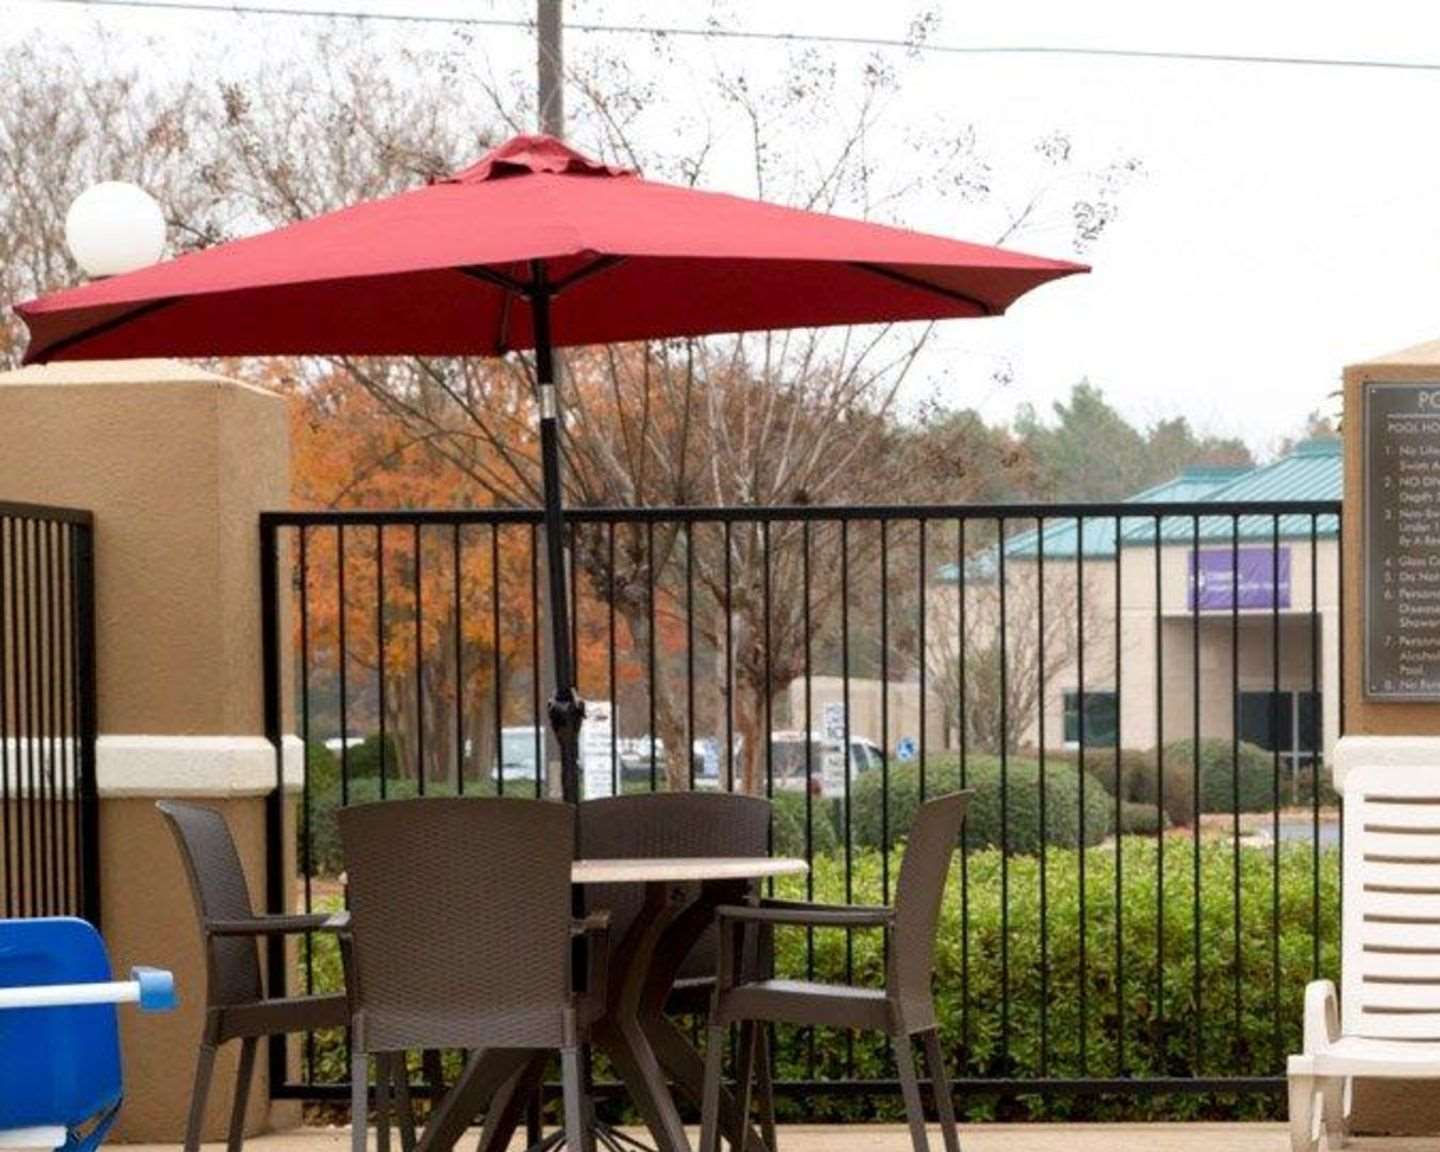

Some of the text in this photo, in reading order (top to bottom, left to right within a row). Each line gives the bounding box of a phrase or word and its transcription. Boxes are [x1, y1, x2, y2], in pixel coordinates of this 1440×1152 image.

[1387, 422, 1419, 433] POOL
[1399, 445, 1416, 456] No
[1400, 460, 1429, 471] Swim
[1399, 475, 1421, 487] NO
[1399, 587, 1440, 598] Persons
[1399, 617, 1440, 629] Shower
[1399, 635, 1440, 647] Persons
[1399, 650, 1440, 662] Alcohol
